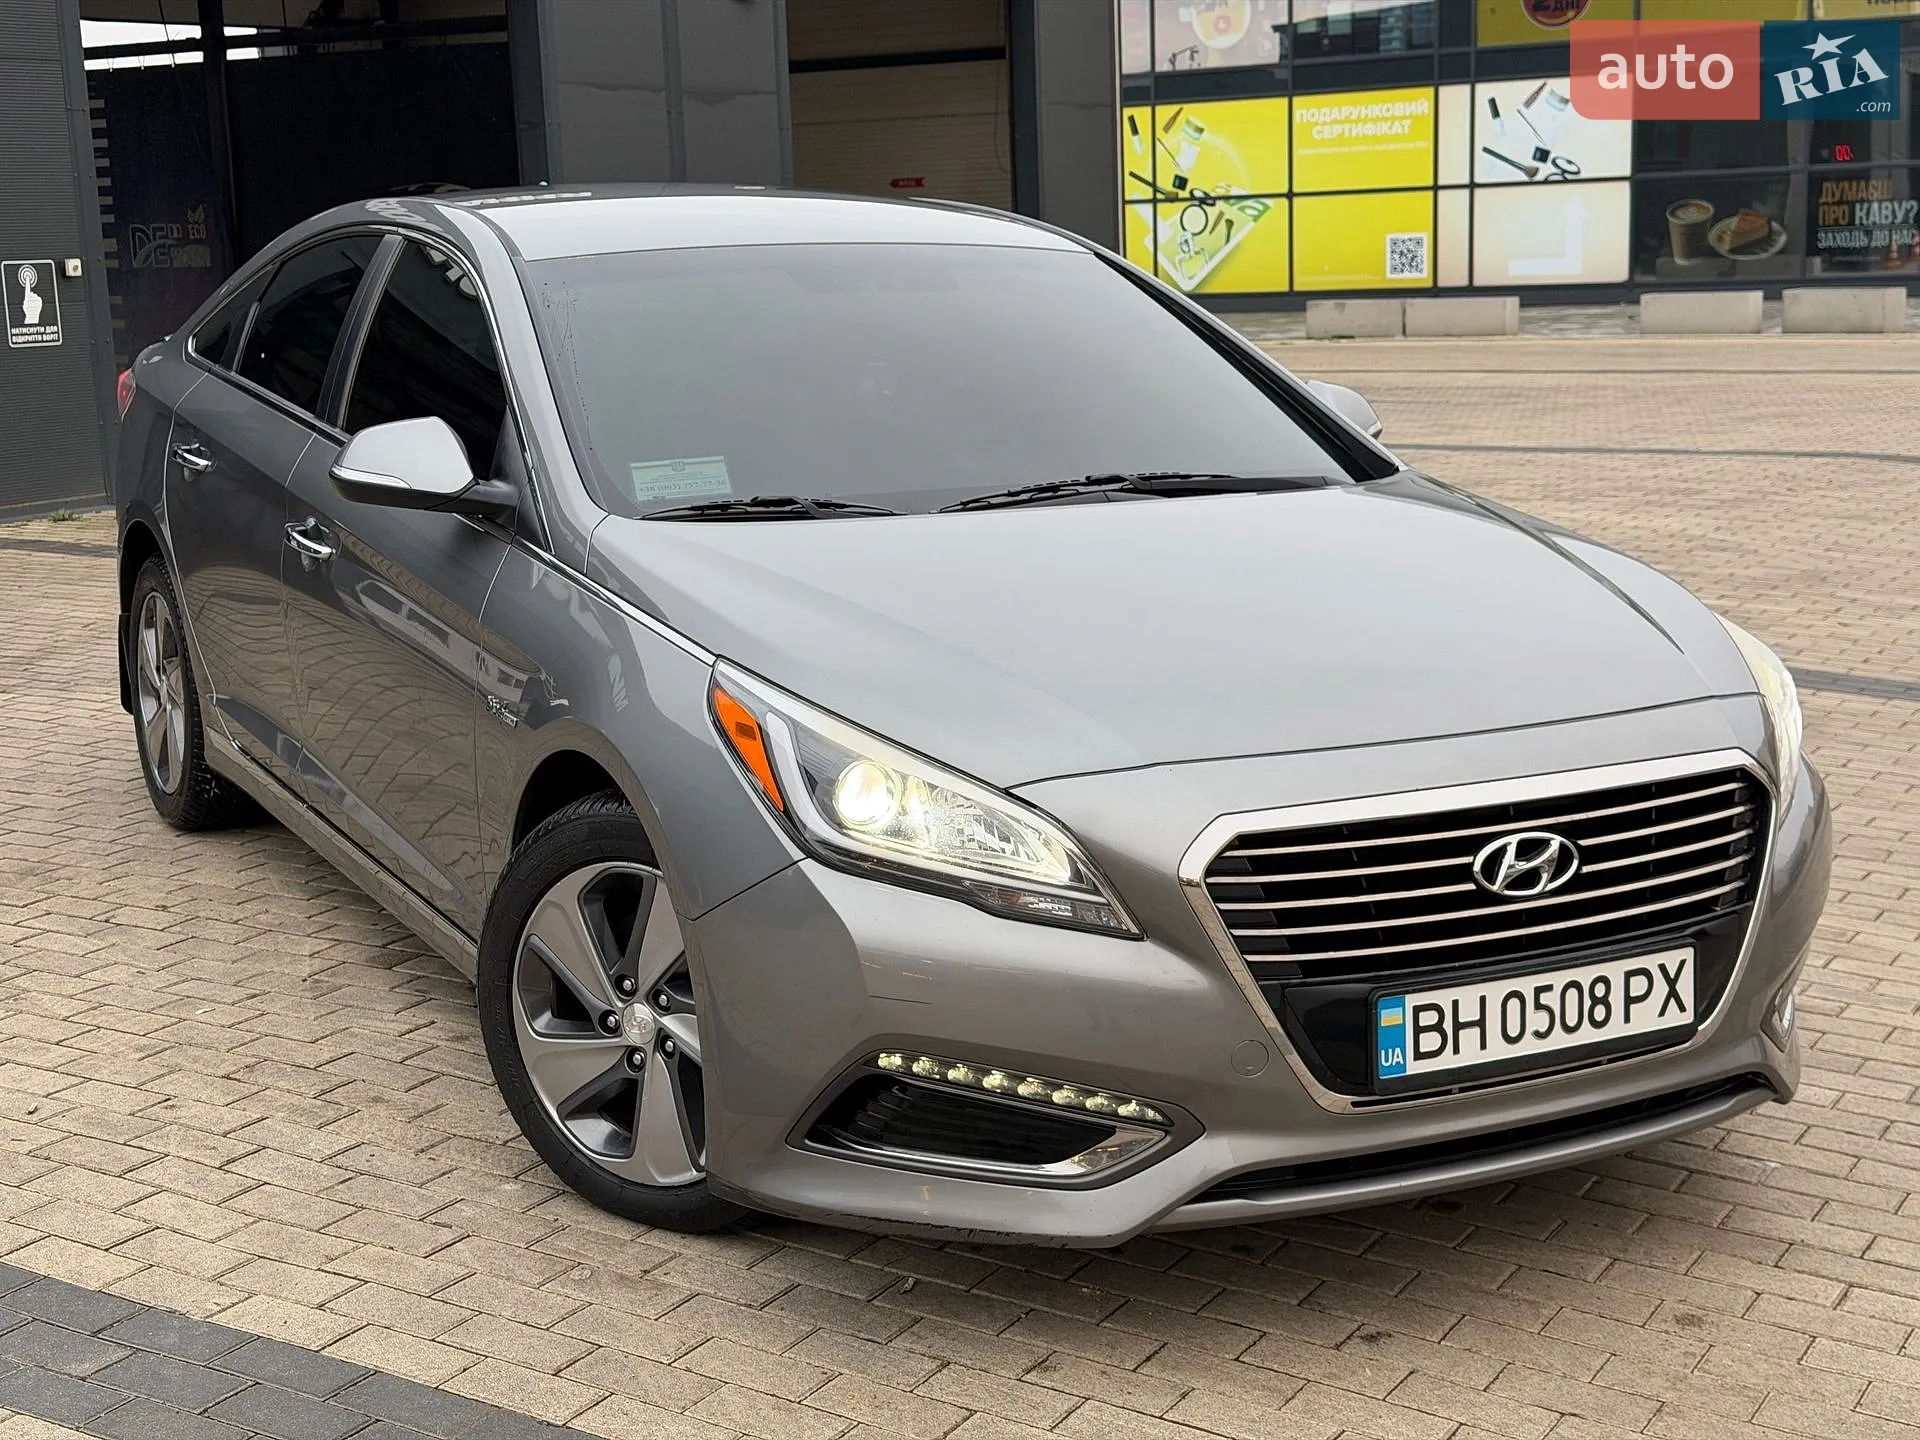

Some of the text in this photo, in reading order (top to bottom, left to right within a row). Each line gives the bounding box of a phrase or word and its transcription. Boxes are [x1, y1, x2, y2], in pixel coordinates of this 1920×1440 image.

[1295, 97, 1430, 123] ПОДАРУНКОВИЙ
[1311, 119, 1412, 140] СЕРТИФІКАТ
[1819, 199, 1919, 227] ПРО КАВУ?
[1816, 229, 1869, 249] ЗАХОДЬ
[1870, 229, 1890, 248] ДО
[1412, 958, 1688, 1062] BH 0508 PX
[1381, 1047, 1404, 1067] UA
